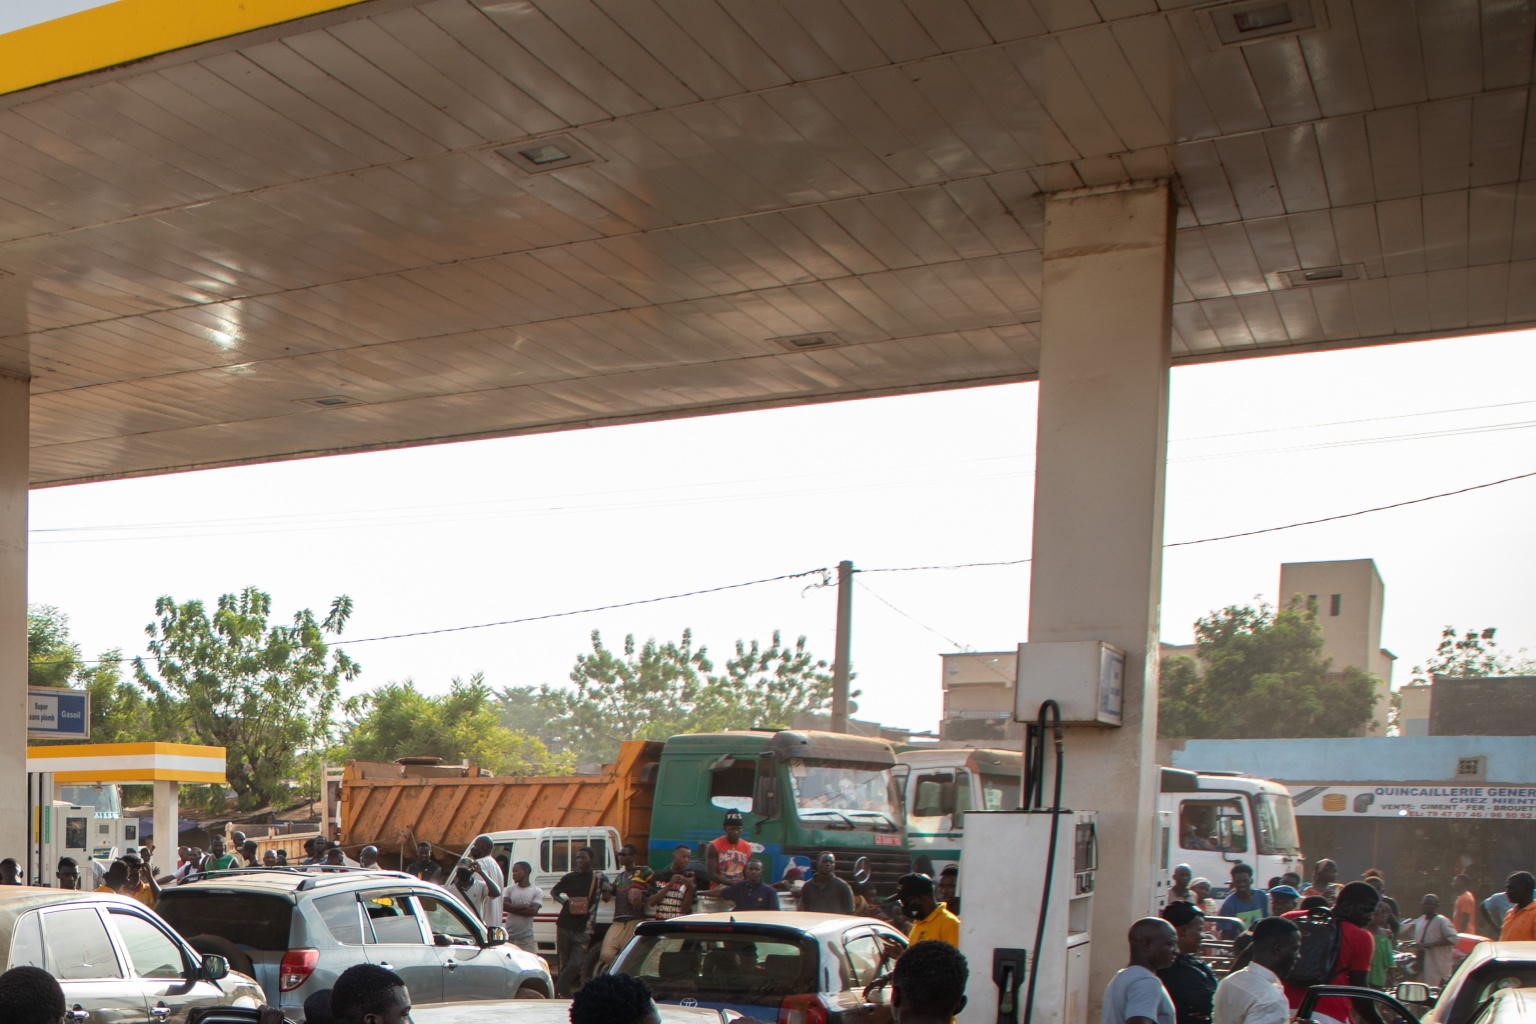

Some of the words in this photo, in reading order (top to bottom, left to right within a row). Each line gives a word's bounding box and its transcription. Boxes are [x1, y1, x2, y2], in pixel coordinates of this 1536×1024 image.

[34, 702, 49, 712] Super
[61, 709, 81, 719] Gasoil
[1375, 787, 1483, 797] QUINCAILLERIE
